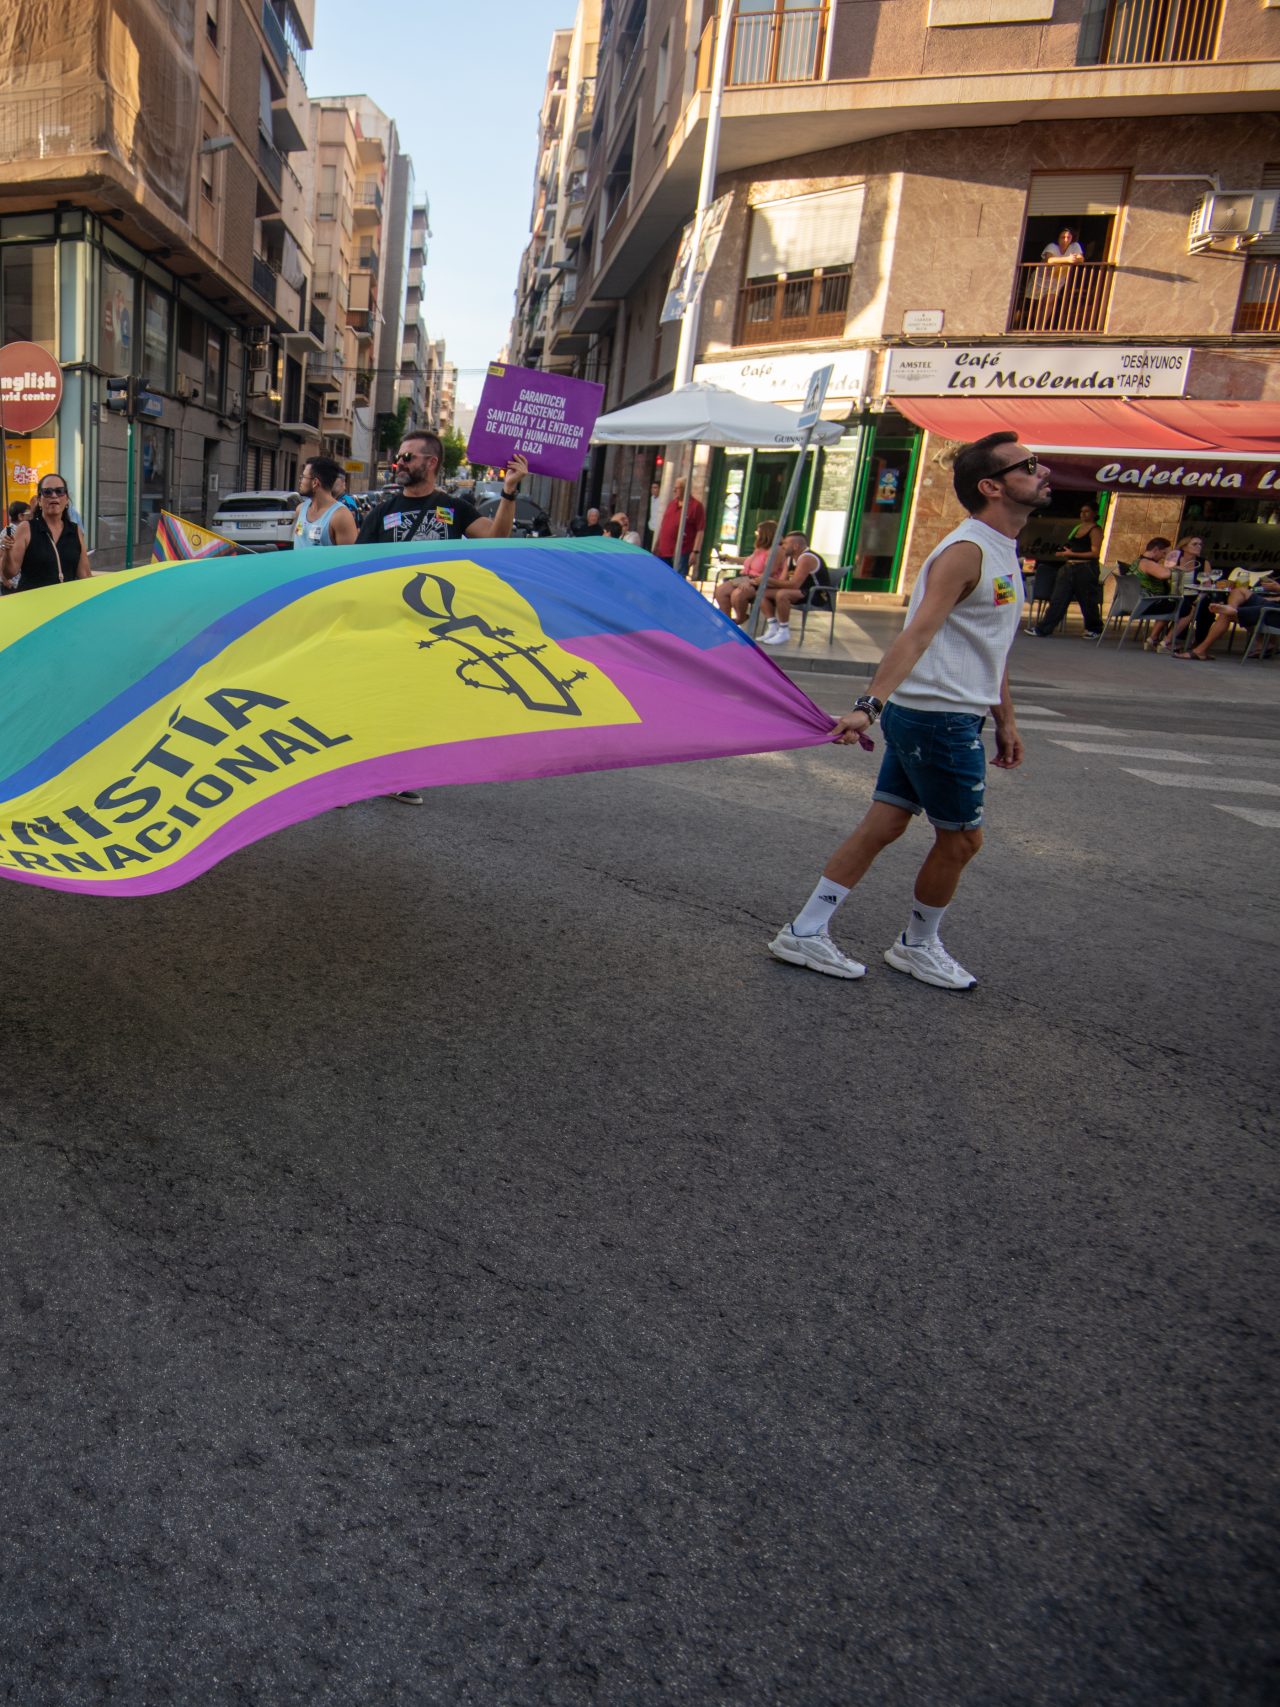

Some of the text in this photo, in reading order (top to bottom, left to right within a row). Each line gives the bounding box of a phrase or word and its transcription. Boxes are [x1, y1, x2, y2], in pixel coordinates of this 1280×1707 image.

[900, 361, 932, 369] AMSTEL
[955, 352, 1002, 369] Café
[741, 364, 773, 378] Café
[947, 371, 1114, 389] La Molenda
[22, 391, 56, 401] center
[520, 389, 566, 408] GARANTICEN
[513, 401, 565, 421] LA ASISTENCIA
[487, 408, 584, 438] SANITARIA Y LA ENTREGA
[485, 421, 579, 449] DE AYUDA HUMANITARIA
[774, 433, 804, 444] GUINN
[514, 439, 543, 454] A GAZA
[1095, 463, 1242, 488] Cafeteria
